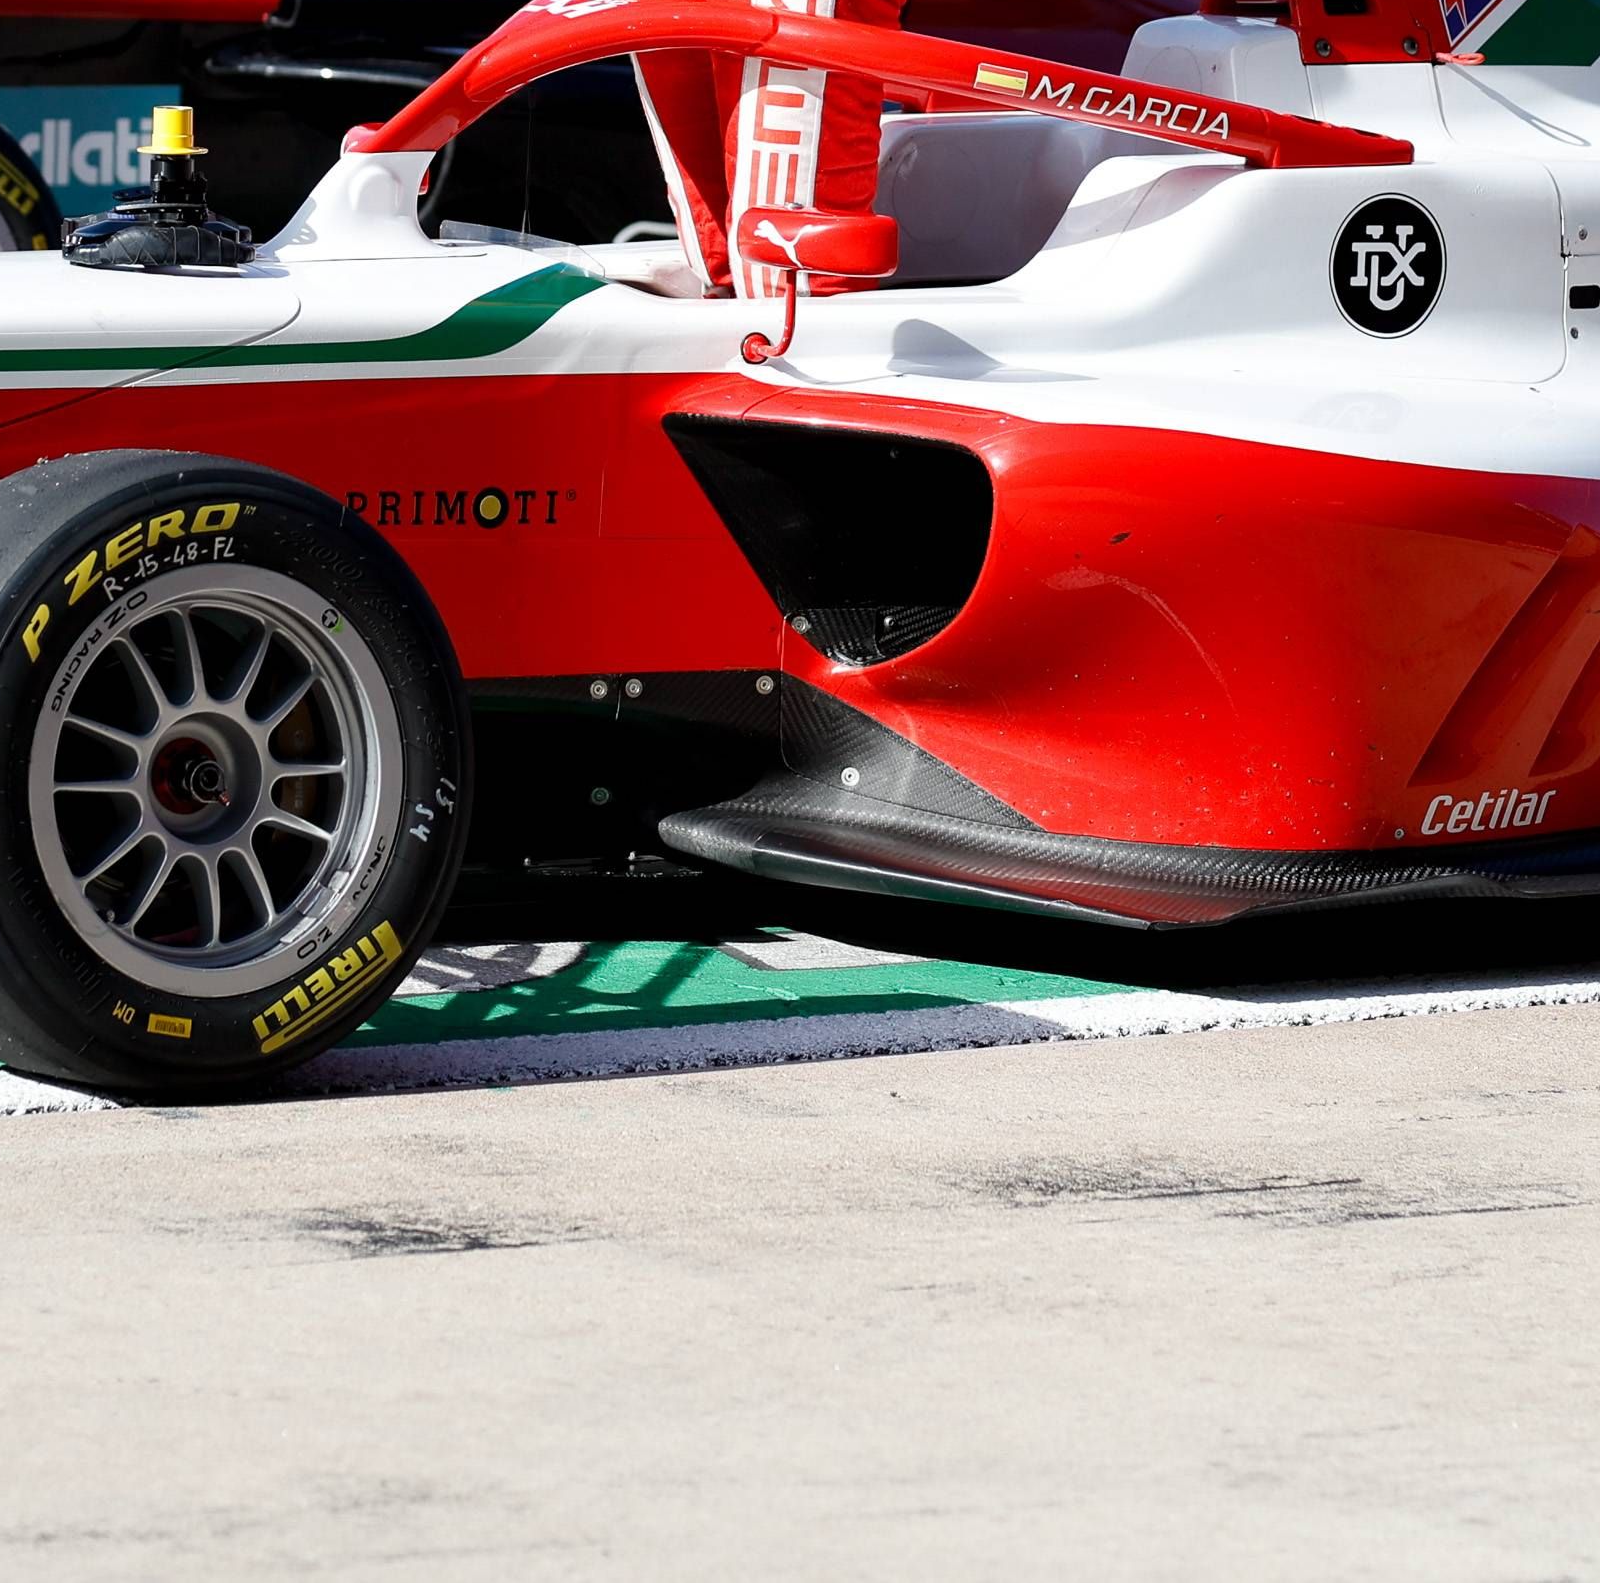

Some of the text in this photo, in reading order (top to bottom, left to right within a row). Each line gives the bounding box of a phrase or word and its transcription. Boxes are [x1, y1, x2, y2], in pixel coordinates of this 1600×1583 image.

[1028, 75, 1232, 141] M.GARCIA
[21, 603, 51, 664] P
[50, 627, 102, 713] RACING
[1420, 789, 1557, 836] Cetilar
[252, 919, 404, 1055] PIRELLI
